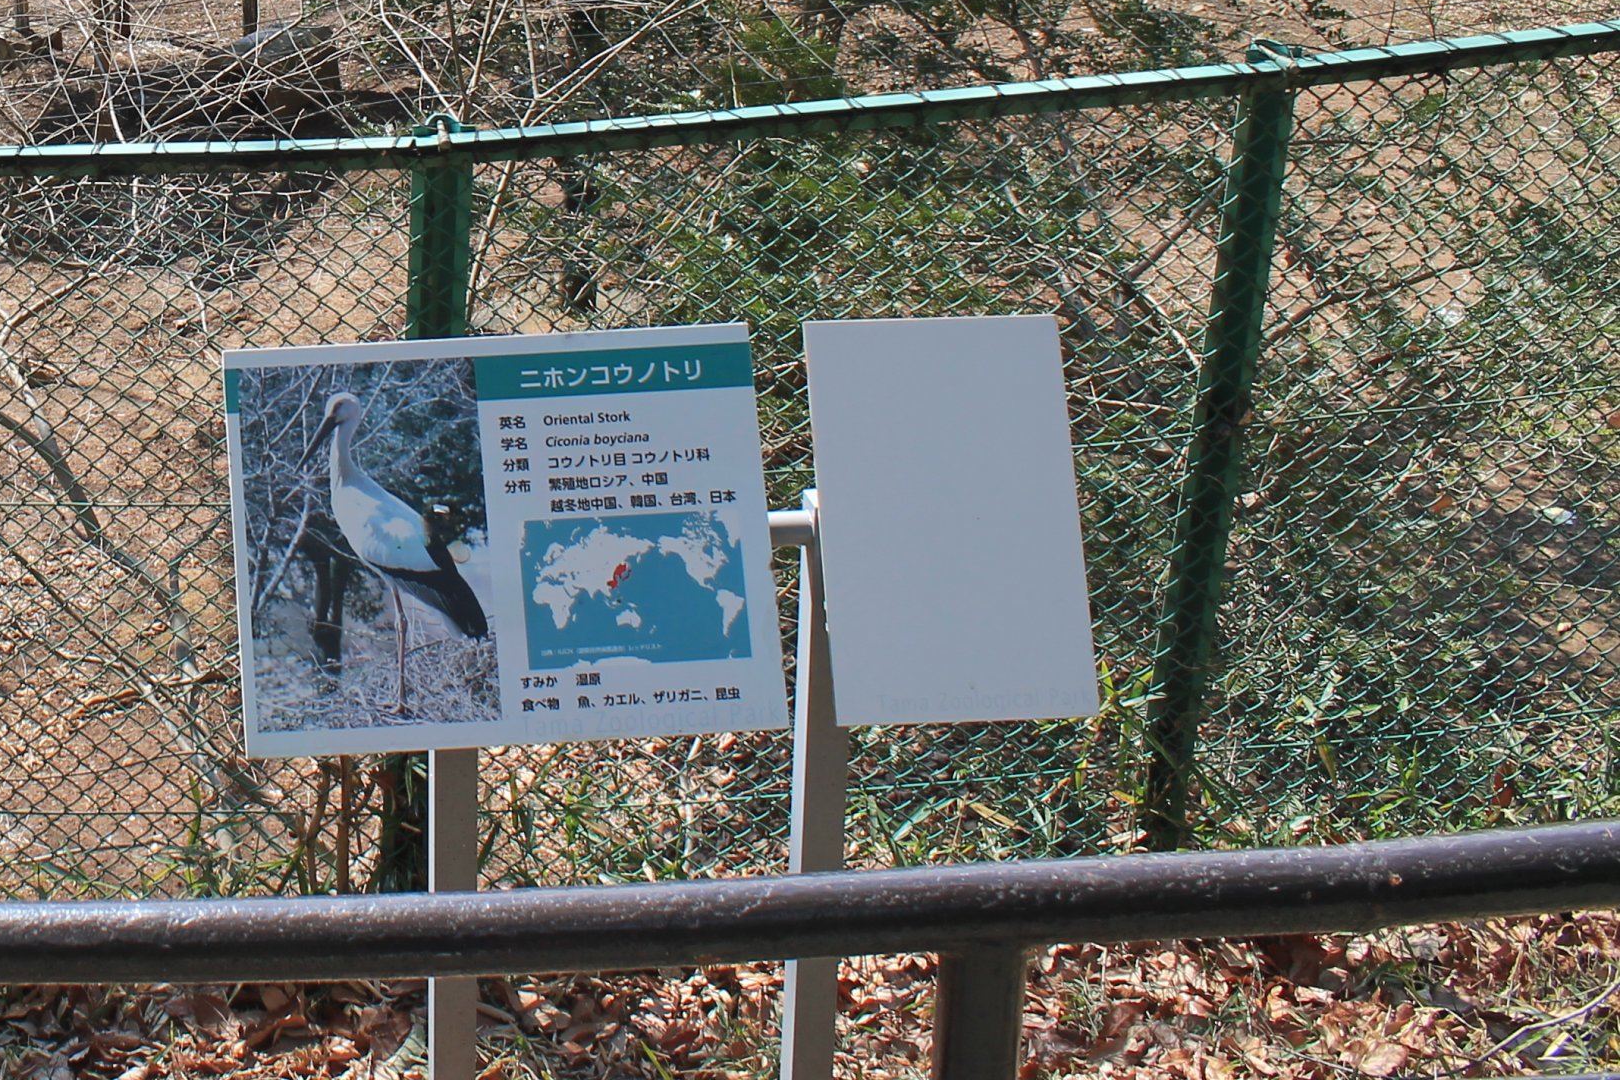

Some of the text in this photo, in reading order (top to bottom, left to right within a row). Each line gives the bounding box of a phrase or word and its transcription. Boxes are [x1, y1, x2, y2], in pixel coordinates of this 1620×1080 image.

[520, 359, 703, 389] ニホンコウノトリ
[498, 411, 631, 430] 英名 Oriental Stork
[500, 431, 650, 452] 学名 Ciconia boyciana
[502, 447, 710, 472] 分類 コウノトリ目 コウノトリ科
[504, 479, 531, 494] 分布
[520, 675, 558, 689] すみか
[521, 697, 560, 712] 食べ物
